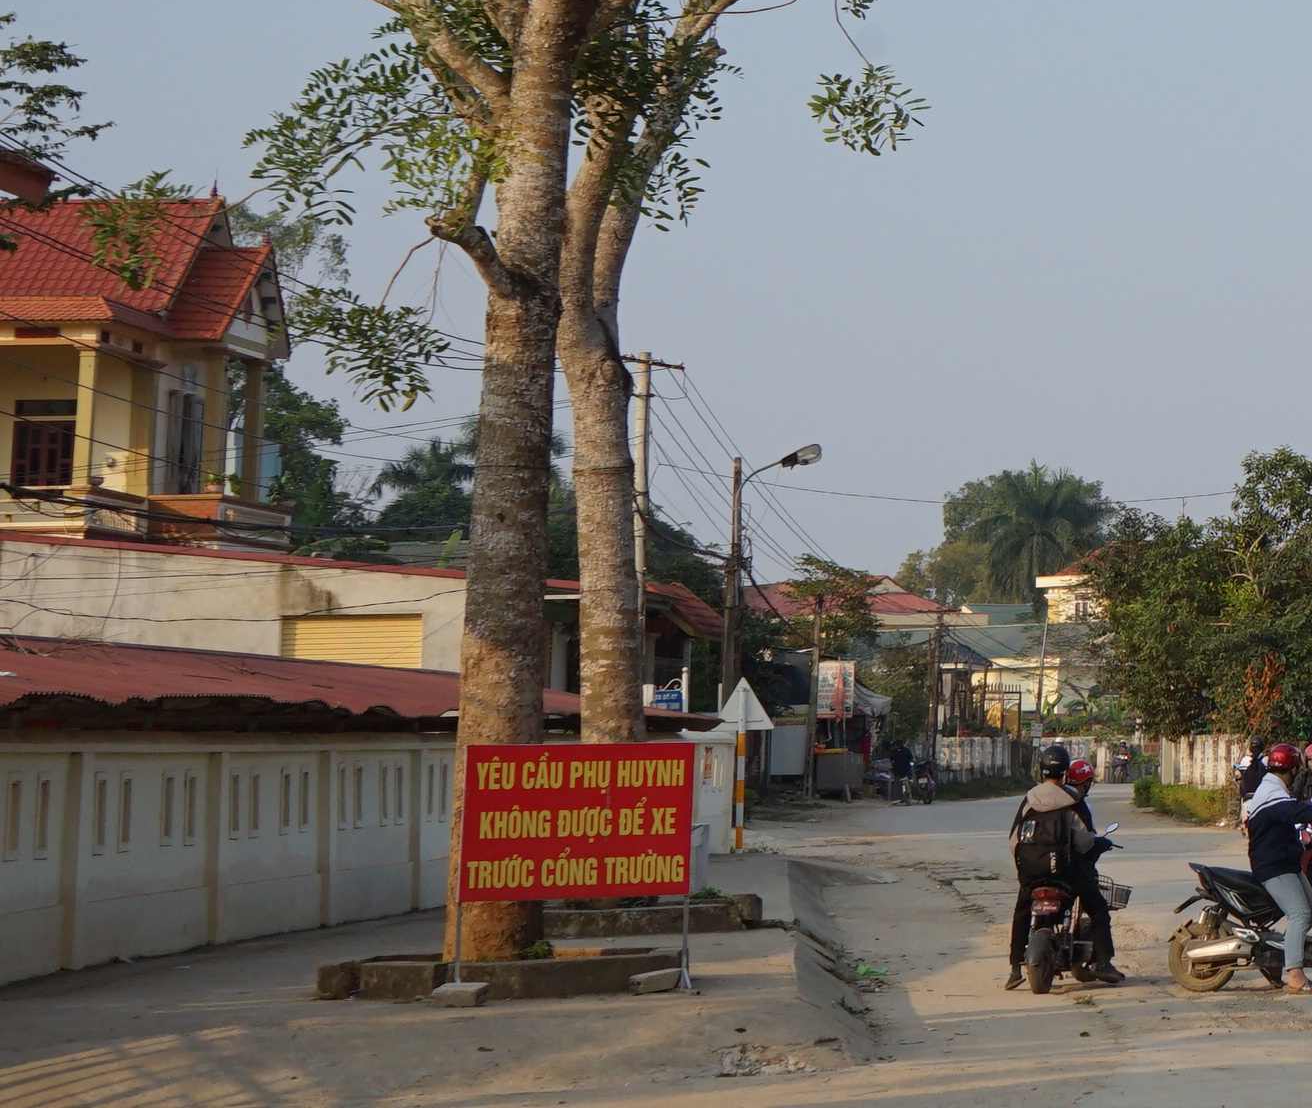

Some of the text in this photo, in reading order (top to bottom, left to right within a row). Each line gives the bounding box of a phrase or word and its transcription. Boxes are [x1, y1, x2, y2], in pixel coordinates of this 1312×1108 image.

[476, 752, 685, 794] YÊU CẦU PHỤ HUYNH
[479, 797, 677, 843] KHÔNG ĐƯỢC ĐỂ XE
[467, 847, 684, 889] TRƯỚC CỔNG TRƯỜNG
